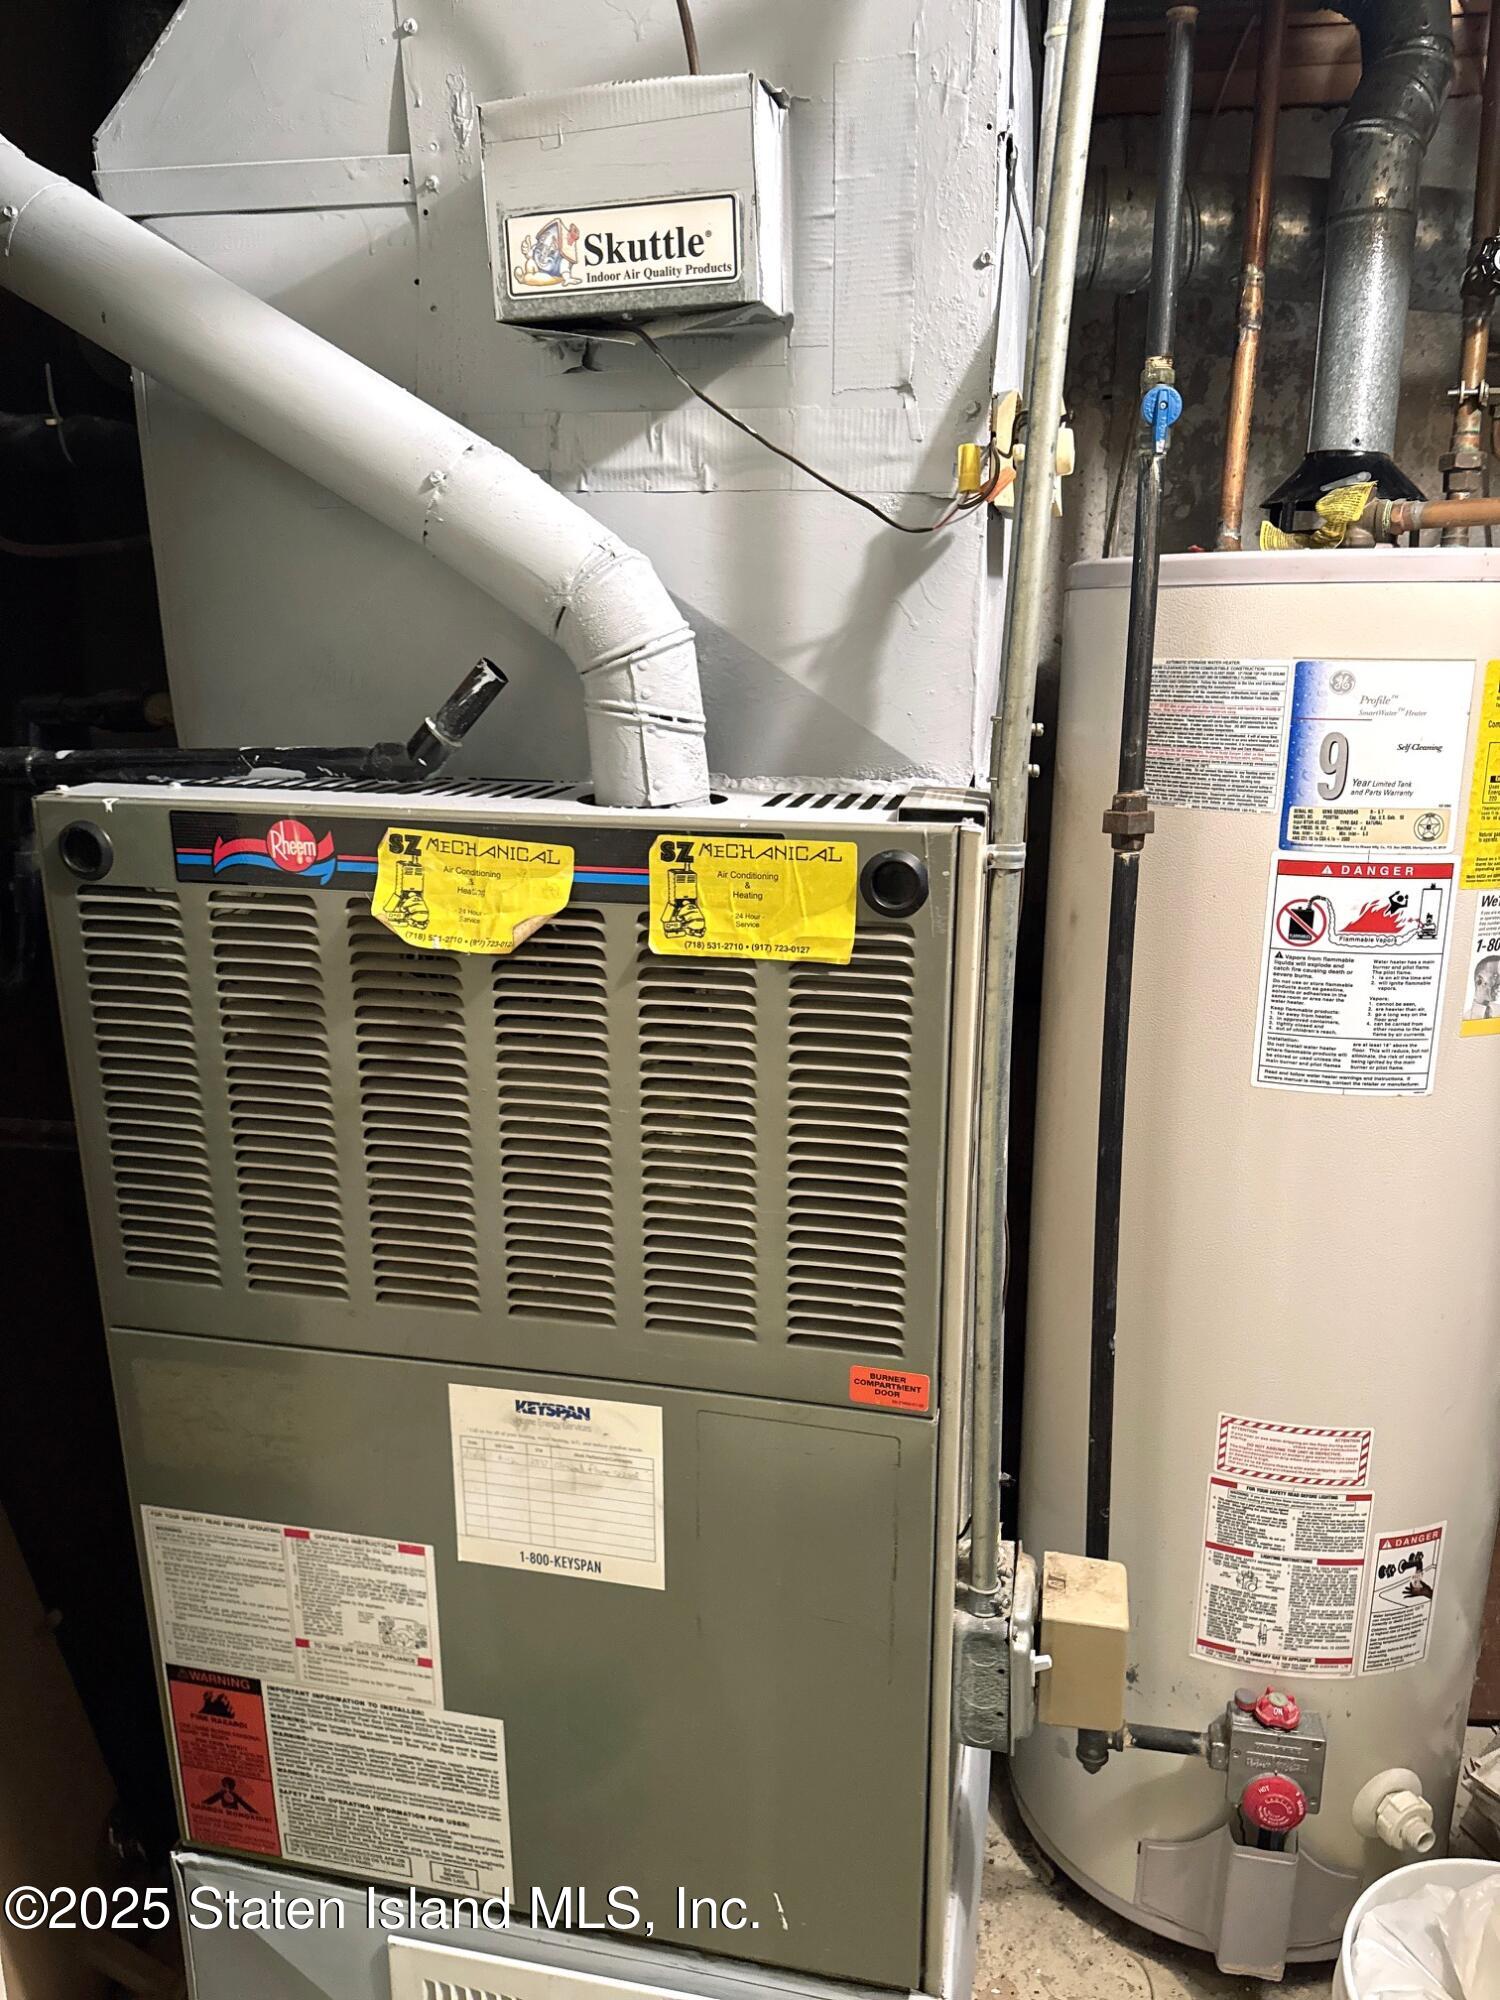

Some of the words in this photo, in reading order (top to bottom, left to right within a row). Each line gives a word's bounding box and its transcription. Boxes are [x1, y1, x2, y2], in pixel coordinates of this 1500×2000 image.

[586, 272, 621, 284] Indoor
[623, 270, 641, 281] Air
[643, 267, 682, 281] Quality
[685, 262, 733, 276] Products
[1317, 731, 1349, 801] 9
[1352, 778, 1372, 788] Year
[1372, 780, 1397, 788] Limited
[1397, 780, 1412, 788] Tank
[1350, 789, 1364, 797] and
[1364, 788, 1382, 796] Parts
[1383, 788, 1414, 797] Warranty
[270, 821, 316, 861] Rheem
[389, 833, 422, 856] SZ
[426, 838, 561, 865] MECHANICAL
[660, 841, 695, 863] SZ
[698, 843, 843, 863] MECHANICAL
[455, 867, 501, 879] Conditioning
[717, 870, 728, 879] Air
[729, 871, 779, 882] Conditioning
[1340, 865, 1415, 876] DANGER
[744, 881, 751, 889] &
[457, 886, 486, 897] Heating
[732, 891, 764, 901] Heating
[735, 920, 760, 929] Service
[684, 941, 705, 950] (718)
[706, 942, 744, 951] 531-2710
[751, 943, 772, 953] (917)
[774, 944, 810, 954] 723-0127
[869, 1373, 907, 1384] BURNER
[854, 1379, 922, 1394] COMPARTMENT
[874, 1389, 900, 1398] DOOR
[515, 1400, 591, 1421] KEYSPAN
[1395, 1531, 1440, 1546] DANGER
[520, 1551, 602, 1574] 1-800-KEYSPAN
[189, 1670, 250, 1690] WARNING
[267, 1685, 310, 1698] IMPORTANT
[311, 1693, 365, 1707] INFORMATION
[1273, 1706, 1284, 1716] ON
[1258, 1785, 1270, 1794] HOT
[313, 1794, 326, 1802] AND
[328, 1798, 371, 1810] OPERATING
[373, 1805, 426, 1819] INFORMATION
[428, 1815, 444, 1823] FOR
